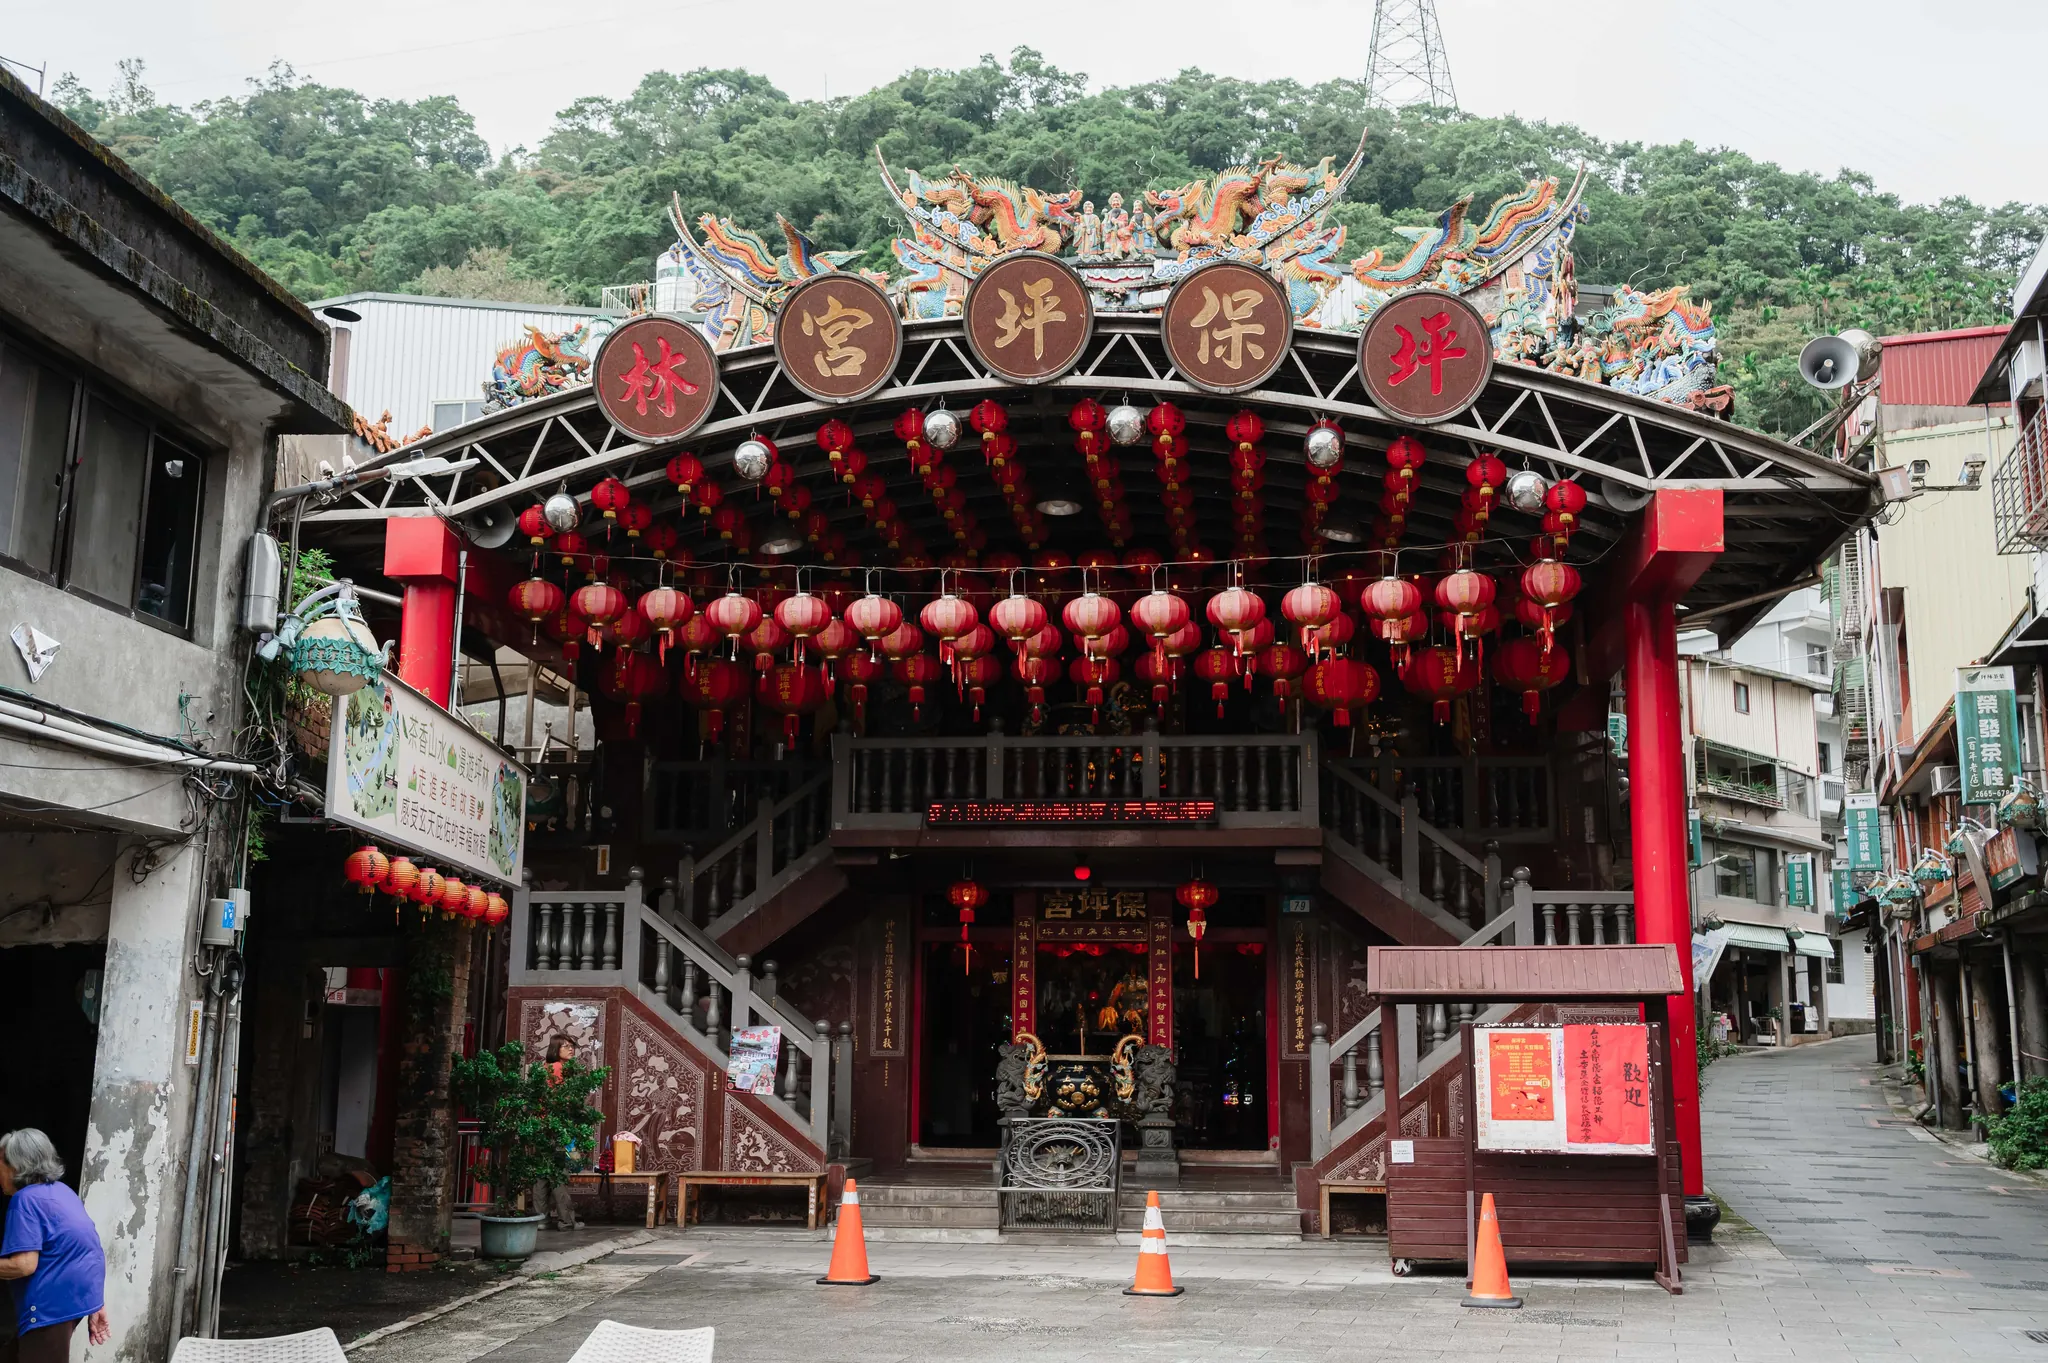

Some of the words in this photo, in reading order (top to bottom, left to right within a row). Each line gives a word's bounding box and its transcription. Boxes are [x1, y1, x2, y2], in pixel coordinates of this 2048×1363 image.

[800, 294, 875, 378] 宮
[994, 276, 1066, 361] 坪
[1196, 284, 1267, 370] 保
[1388, 309, 1470, 393] 坪
[619, 335, 700, 418] 林
[408, 713, 447, 765] 茶香山水
[1976, 694, 2004, 787] 榮發茶棧
[400, 795, 487, 859] 感受玄天庇佑的幸福旅程
[418, 765, 477, 820] 走進老街故事
[1043, 887, 1148, 920] 保坪宮
[1294, 901, 1306, 911] 79
[1623, 1062, 1646, 1108] 歡迎
